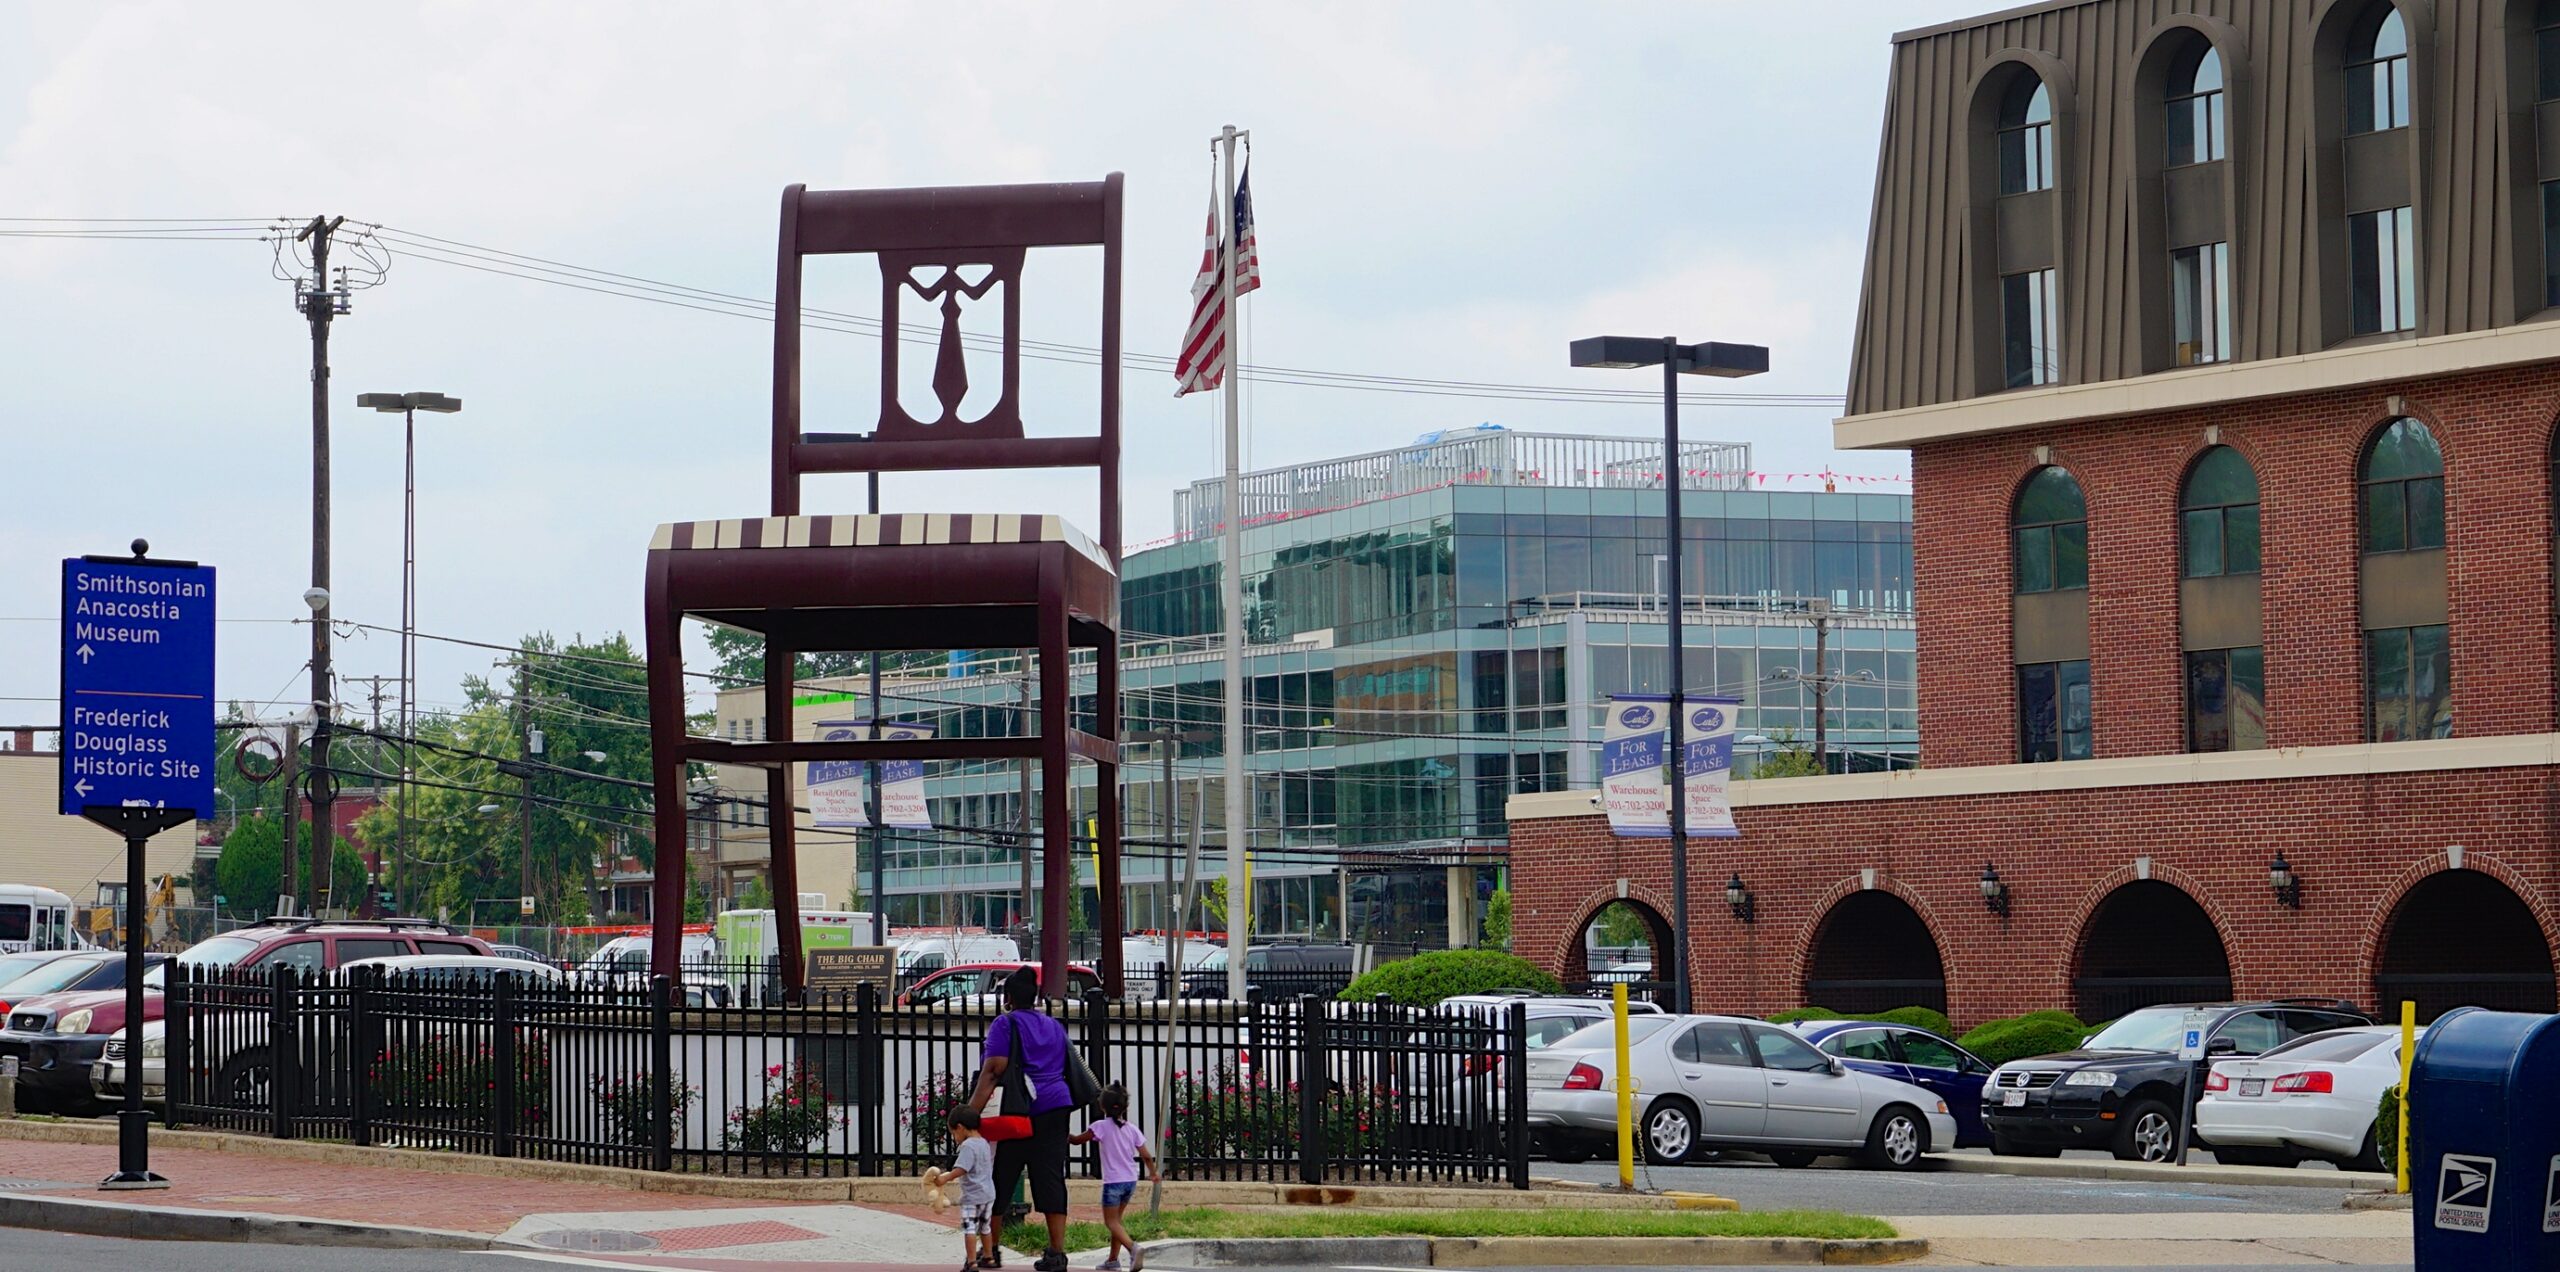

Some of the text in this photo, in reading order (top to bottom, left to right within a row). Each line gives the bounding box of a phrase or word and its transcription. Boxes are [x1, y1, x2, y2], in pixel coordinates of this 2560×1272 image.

[77, 573, 206, 597] Smithsonian
[76, 597, 180, 620] Anacostia
[76, 622, 160, 644] Museum
[74, 707, 170, 729] Frederick
[74, 732, 167, 755] Douglass
[1620, 740, 1647, 757] FOR
[1691, 743, 1717, 759] FOR
[74, 757, 200, 779] Historic Site
[1611, 753, 1655, 773] LEASE
[1684, 756, 1724, 775] LEASE
[815, 766, 857, 783] LEASE
[882, 766, 917, 783] EASE
[813, 788, 858, 798] Retail/Office
[881, 791, 919, 801] arehouse
[1610, 784, 1658, 795] Warehouse
[1684, 784, 1724, 795] etail/Office
[826, 797, 846, 806] Space
[1607, 800, 1666, 811] 301-702-3200
[1691, 794, 1712, 804] Space
[1685, 806, 1725, 816] 01-702-3200
[817, 954, 885, 963] THE BIG CHAIR
[2439, 1208, 2483, 1219] UNITED STATES
[2438, 1216, 2485, 1228] POSTAL SERVICE
